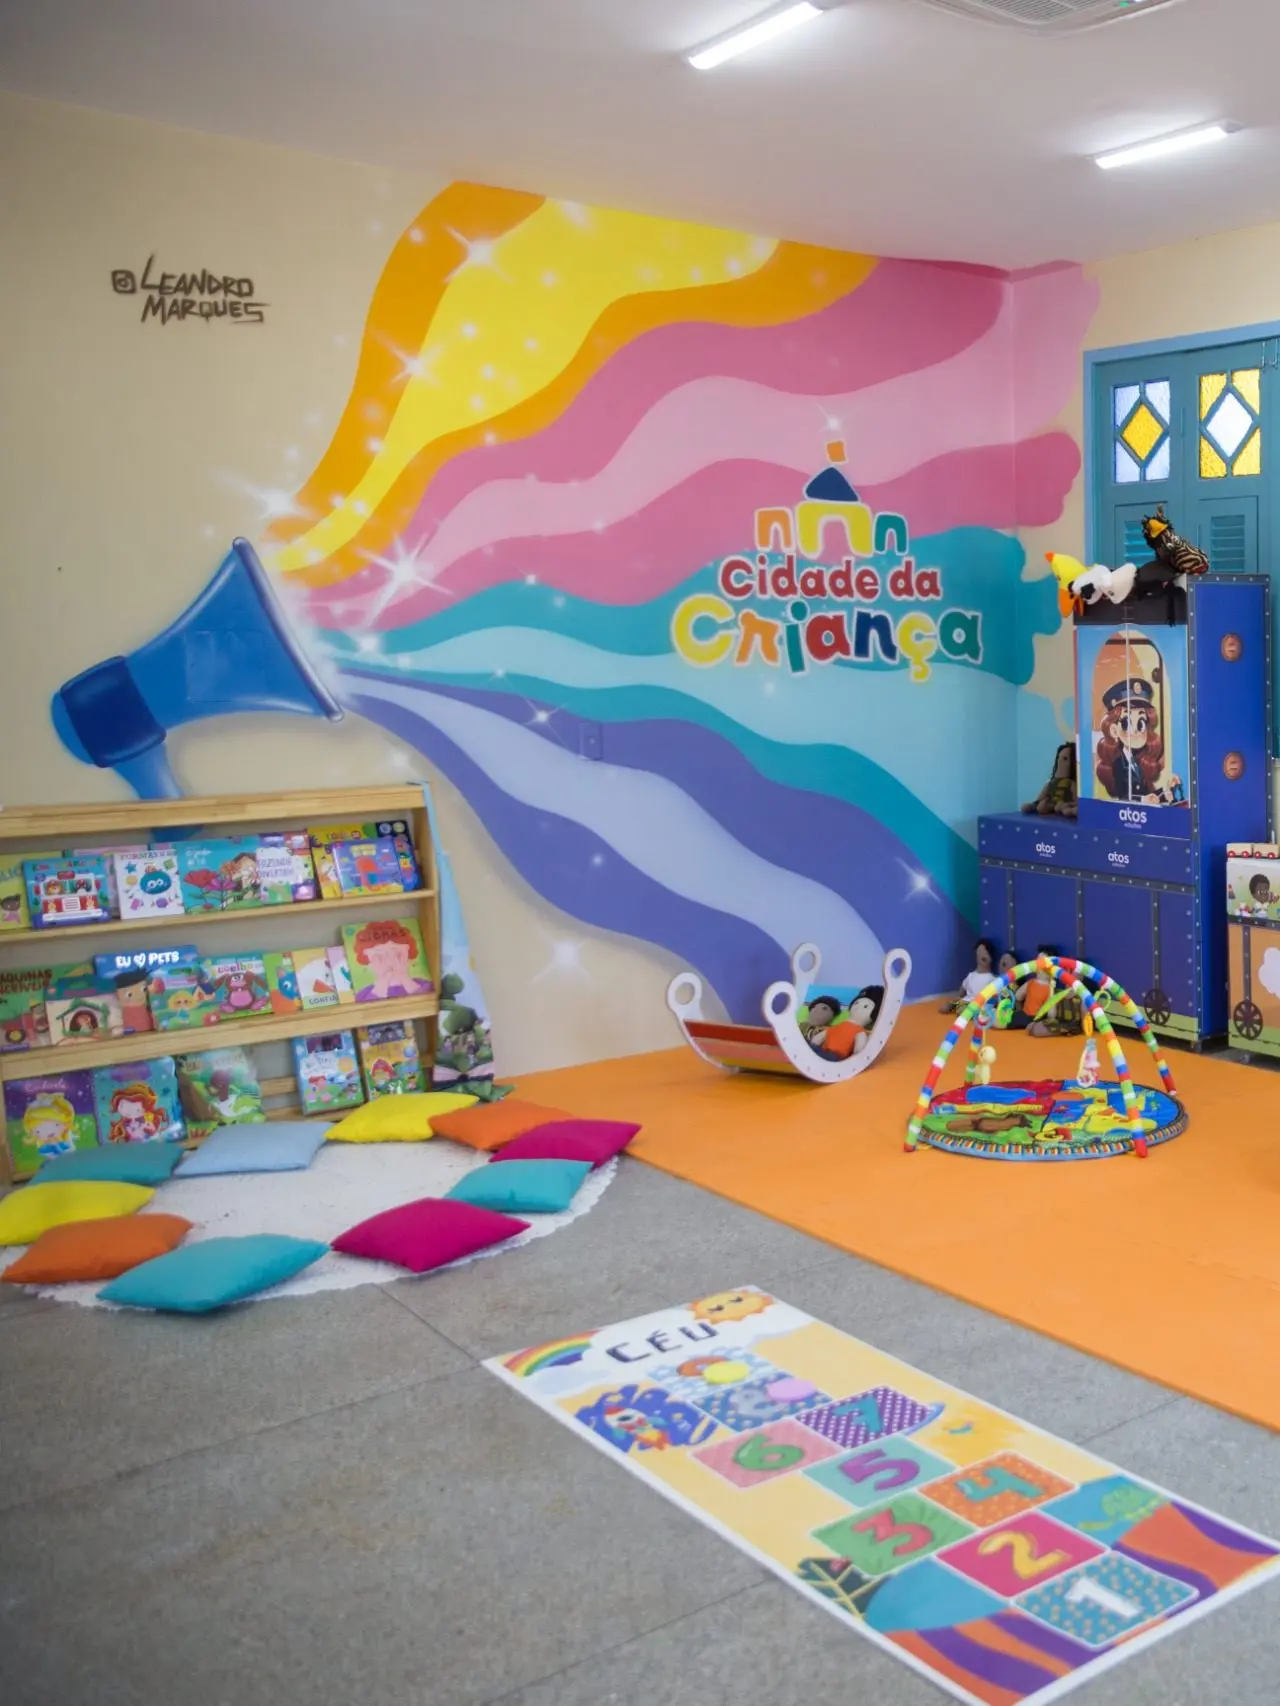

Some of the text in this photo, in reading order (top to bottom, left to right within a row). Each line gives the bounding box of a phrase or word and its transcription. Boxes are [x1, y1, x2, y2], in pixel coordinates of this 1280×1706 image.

[141, 295, 271, 325] MARQUES
[720, 555, 942, 600] Cidade da
[671, 594, 984, 683] Criança
[1119, 807, 1147, 824] atos
[1036, 842, 1056, 854] atos
[1108, 851, 1130, 864] atos
[116, 951, 179, 968] EU PETS
[605, 1322, 719, 1363] CÉU
[833, 1394, 885, 1435] 7
[732, 1434, 805, 1472] 6
[838, 1449, 921, 1491] 5
[956, 1466, 1046, 1504] 4
[852, 1508, 935, 1556] 3
[977, 1530, 1074, 1581] 2
[1064, 1577, 1148, 1619] 1
